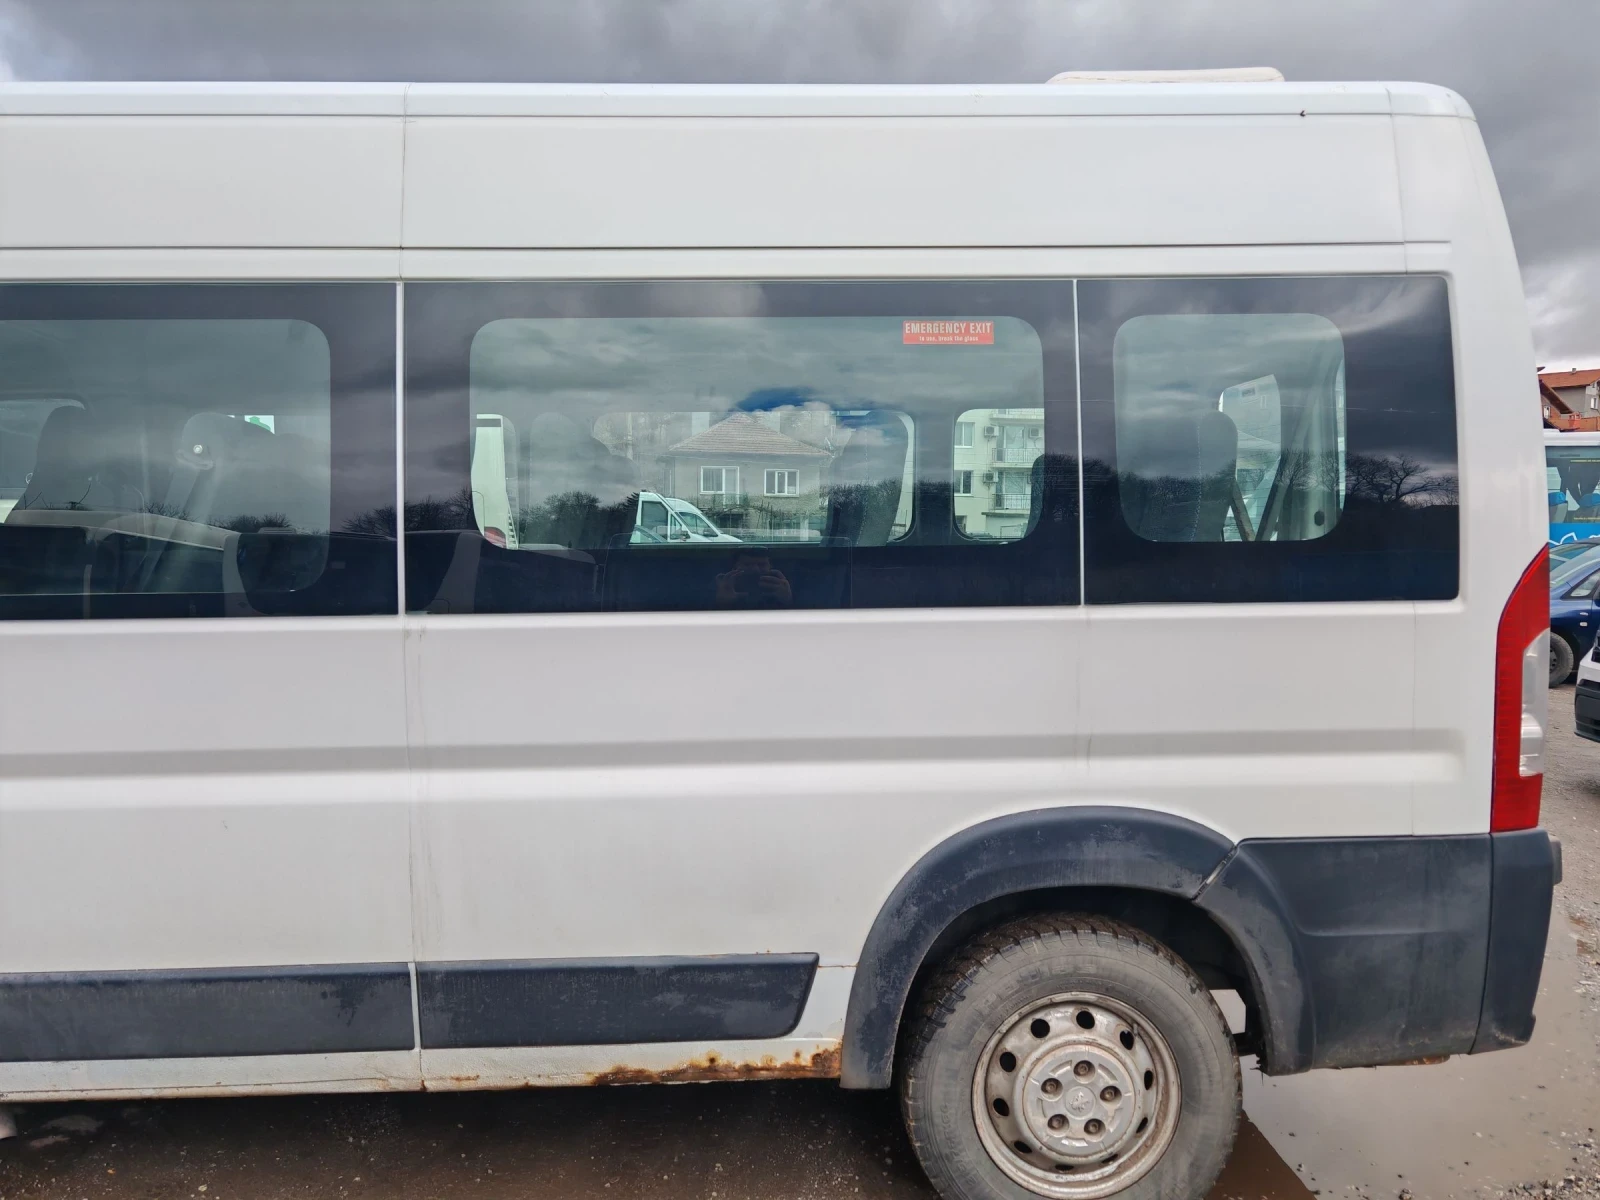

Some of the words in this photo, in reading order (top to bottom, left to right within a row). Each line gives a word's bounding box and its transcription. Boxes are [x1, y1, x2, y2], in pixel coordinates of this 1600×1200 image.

[905, 322, 967, 334] EMERGENCY
[969, 322, 992, 334] EXIT
[964, 335, 979, 343] glass
